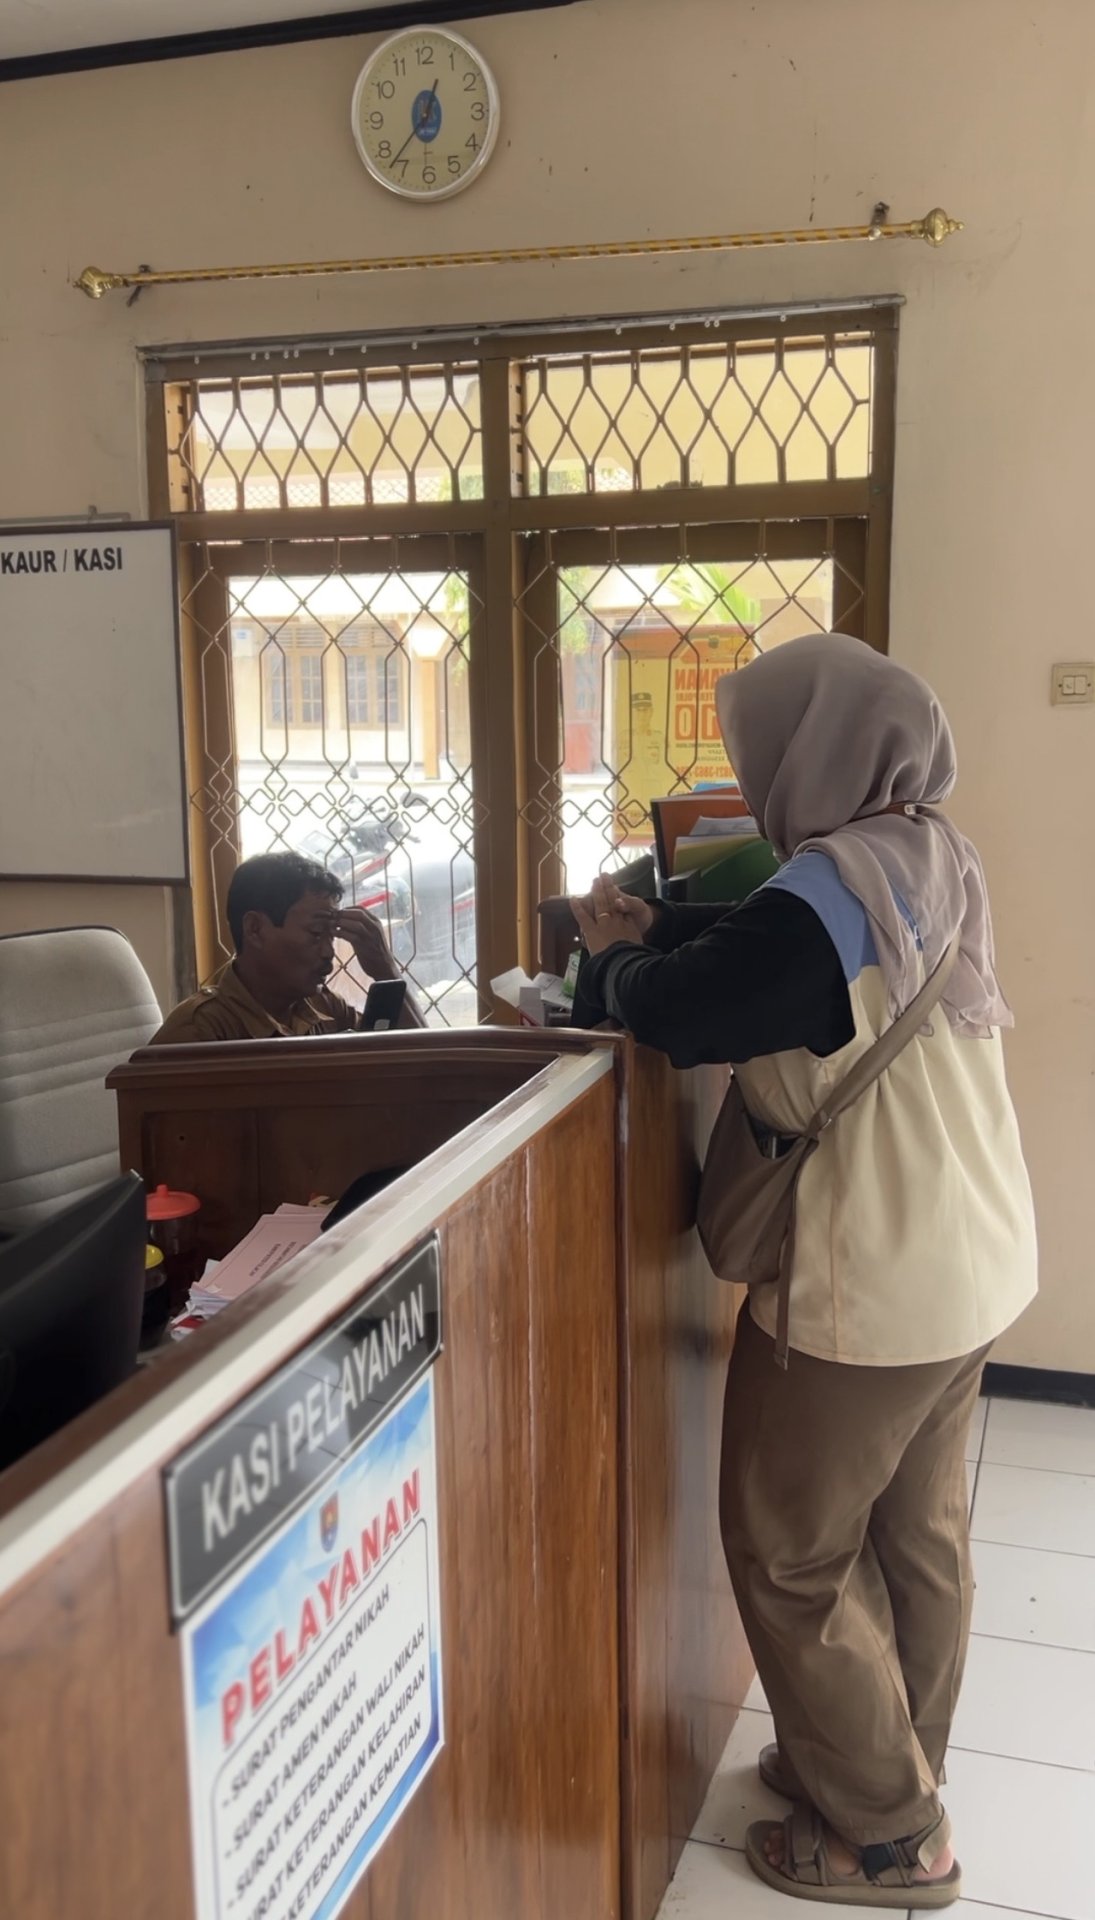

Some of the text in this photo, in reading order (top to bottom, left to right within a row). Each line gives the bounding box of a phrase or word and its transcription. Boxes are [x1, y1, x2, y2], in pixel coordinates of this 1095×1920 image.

[415, 46, 434, 66] 12
[449, 52, 455, 71] 1
[393, 57, 406, 76] 11
[376, 80, 396, 99] 10
[463, 72, 477, 92] 2
[369, 111, 384, 130] 9
[470, 102, 485, 121] 3
[378, 140, 392, 159] 8
[465, 133, 479, 151] 4
[396, 159, 410, 178] 7
[447, 155, 461, 174] 5
[422, 166, 436, 184] 6
[1, 546, 123, 575] KAUR / KASI
[202, 1283, 425, 1552] KASI PELAYANAN
[221, 1468, 421, 1747] PELAYANAN
[232, 1725, 278, 1800] SURAT
[280, 1630, 354, 1740] PENGANTAR
[354, 1583, 390, 1643] NIKAH
[233, 1773, 280, 1851] SURAT
[281, 1723, 319, 1789] AMEN
[321, 1670, 357, 1735] NIKAH
[236, 1820, 282, 1901] SURAT
[284, 1705, 365, 1835] KETERANGAN
[365, 1667, 393, 1716] WALI
[394, 1621, 425, 1679] NIKAH
[369, 1711, 422, 1803] KEMATIAN
[286, 1749, 366, 1880] KETERANGAN
[368, 1664, 425, 1760] KELAHIRAN
